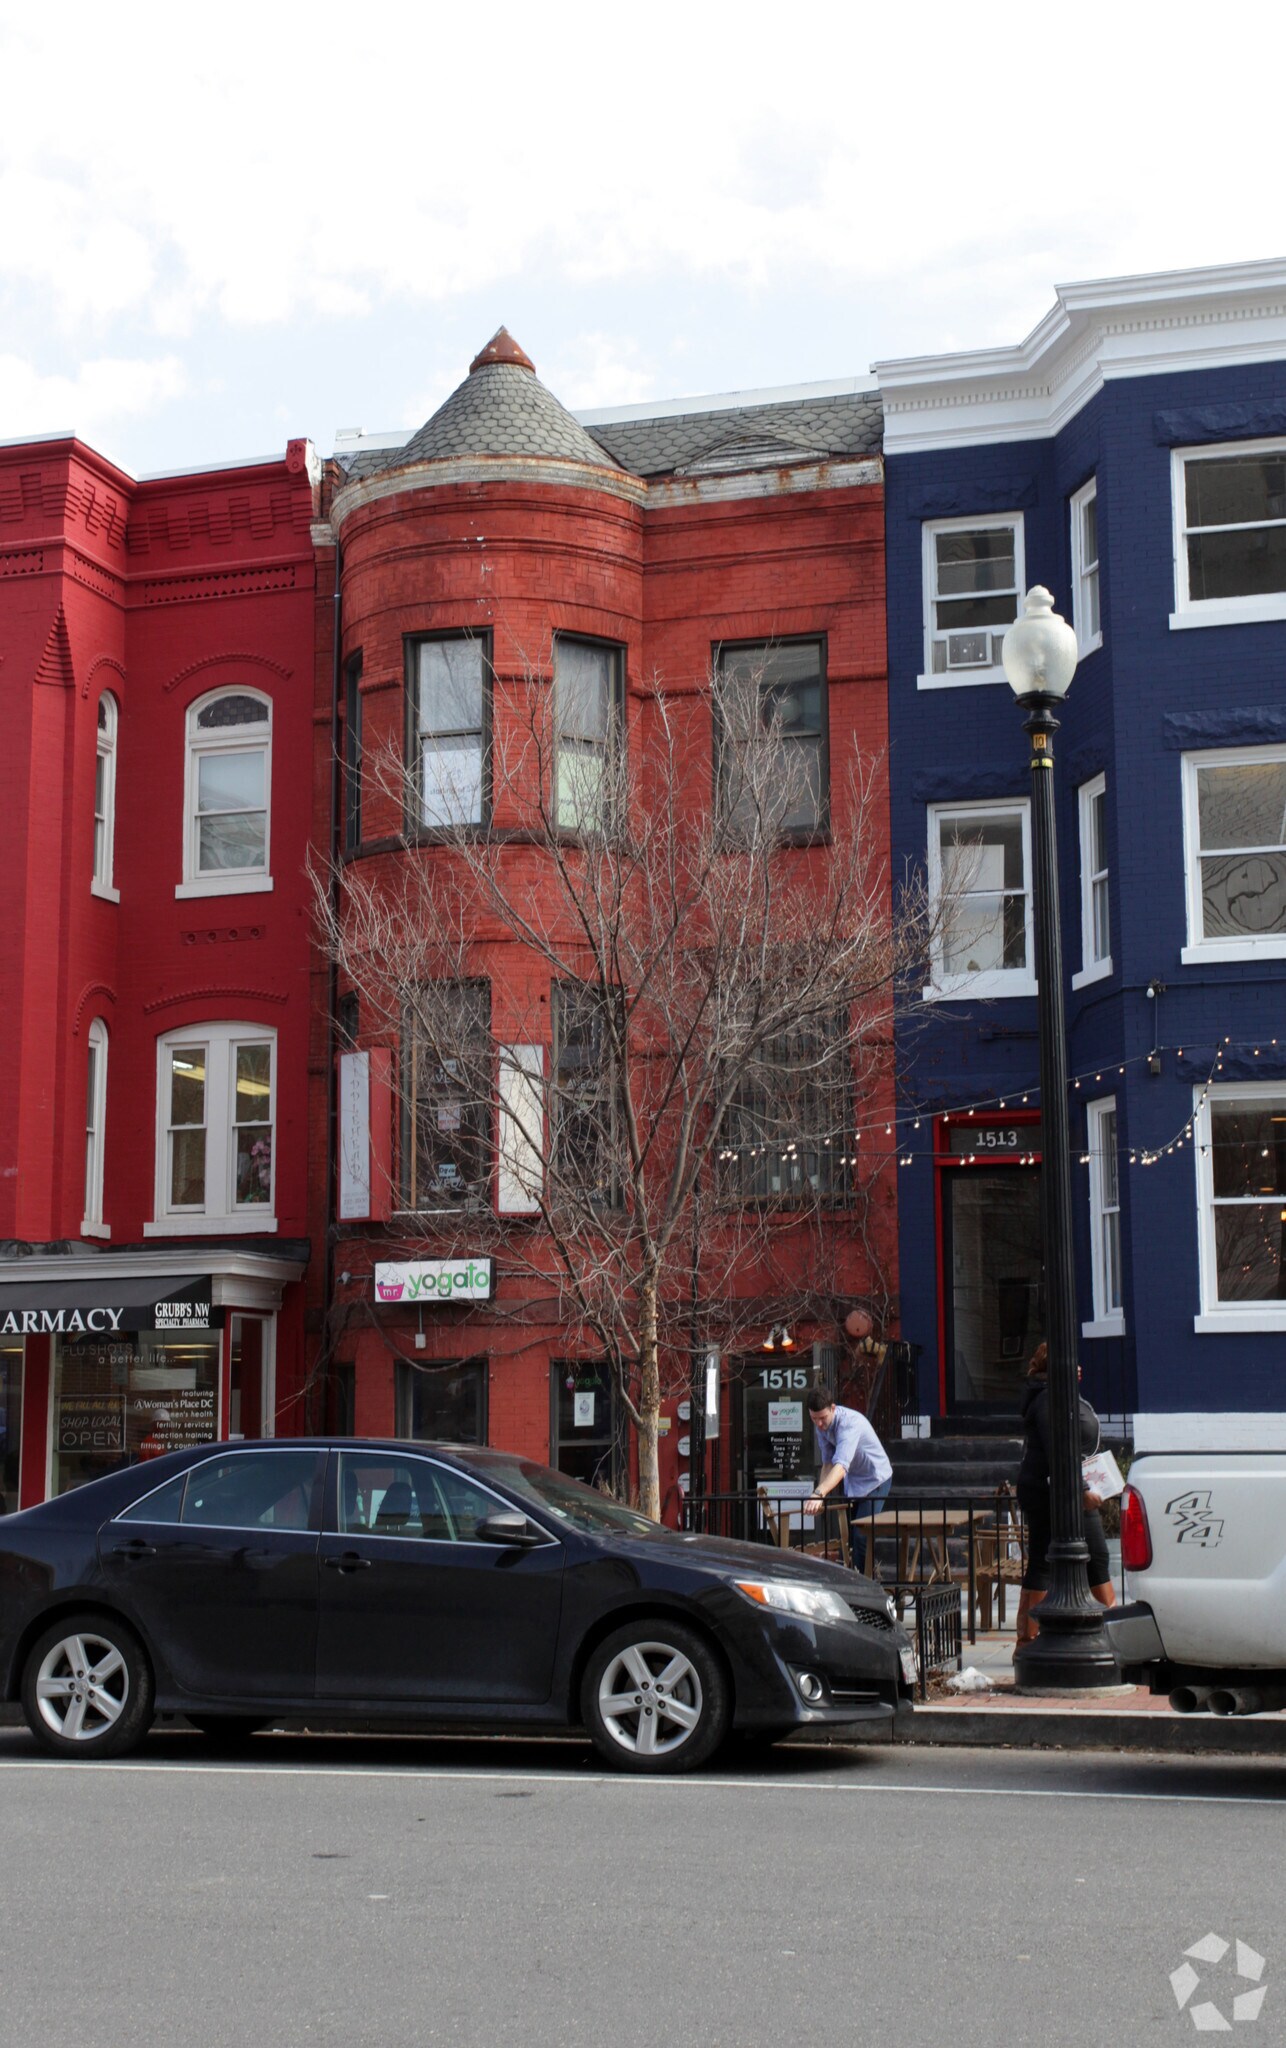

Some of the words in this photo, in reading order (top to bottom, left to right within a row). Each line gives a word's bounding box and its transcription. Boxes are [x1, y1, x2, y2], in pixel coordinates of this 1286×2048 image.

[1035, 736, 1045, 747] 10
[976, 1131, 1018, 1148] 1513
[382, 1288, 400, 1298] mr.
[408, 1262, 490, 1299] yogato
[155, 1302, 192, 1317] GRUBB'S
[194, 1302, 210, 1317] NW
[182, 1317, 210, 1327] PHARMACY
[89, 1343, 134, 1356] SHOTS
[110, 1354, 145, 1364] better
[759, 1369, 808, 1389] 1515
[181, 1390, 214, 1398] featuring
[180, 1399, 200, 1408] Place
[200, 1399, 214, 1408] DC
[190, 1410, 214, 1418] health
[61, 1416, 89, 1428] SHOP
[91, 1415, 122, 1428] LOCAL
[62, 1431, 121, 1446] OPEN
[152, 1432, 183, 1440] injection
[185, 1432, 213, 1440] training
[140, 1442, 165, 1451] fittings
